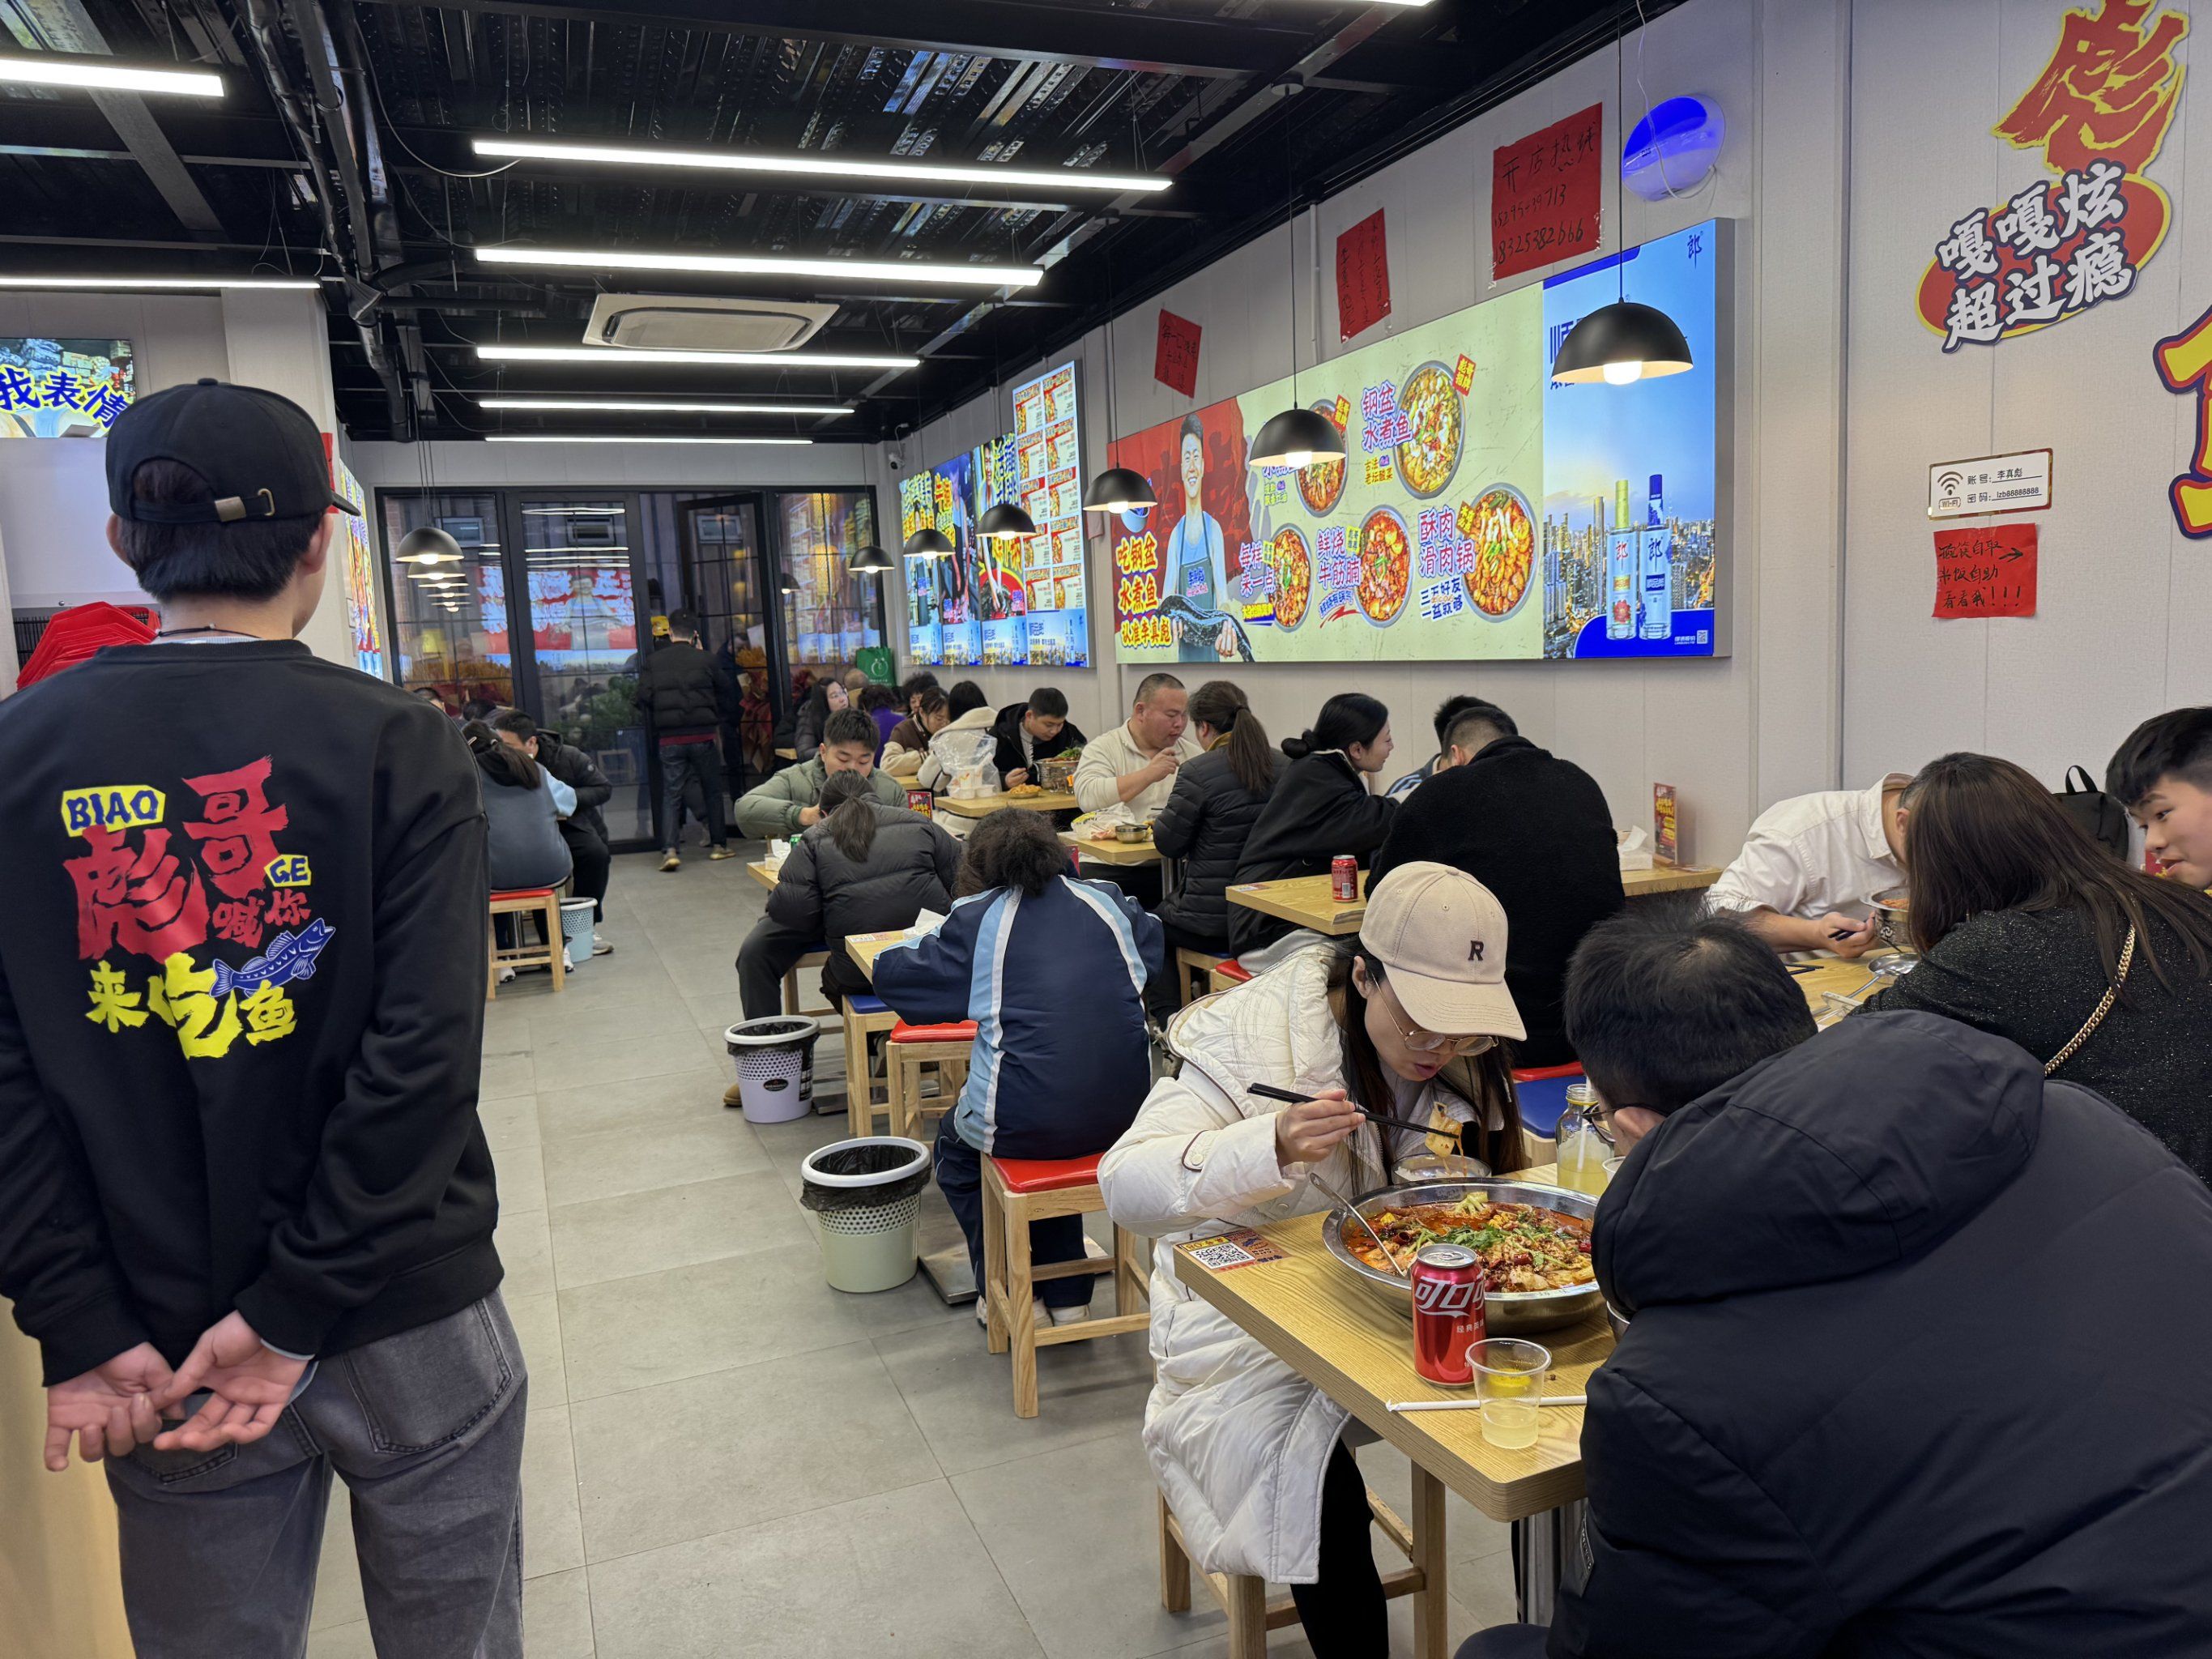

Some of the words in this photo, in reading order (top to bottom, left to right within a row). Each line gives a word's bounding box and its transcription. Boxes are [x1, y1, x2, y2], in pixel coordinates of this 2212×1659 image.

[1938, 163, 2126, 280] 嘎嘎炫
[1943, 232, 2134, 350] 超过瘾
[1362, 382, 1395, 419] 钢盆
[1363, 412, 1413, 452] 水煮鱼
[1997, 468, 2022, 480] 李真彪
[1420, 505, 1455, 542] 酥肉
[1117, 533, 1157, 573] 吃钢盆
[1240, 541, 1263, 569] 每样
[1318, 528, 1345, 558] 鲜烧
[1420, 540, 1475, 576] 滑肉锅
[1241, 567, 1275, 596] 来一点
[1318, 555, 1361, 588] 牛筋腩
[1938, 565, 1999, 584] 米饭自助
[1119, 574, 1158, 613] 水煮鱼
[1421, 578, 1461, 605] 三五好友
[1122, 616, 1171, 646] 认准李真彪
[66, 790, 159, 830] BIAO
[270, 857, 309, 884] GE
[213, 889, 311, 948] 喊你
[1468, 940, 1484, 962] R
[85, 953, 297, 1060] 来吃鱼
